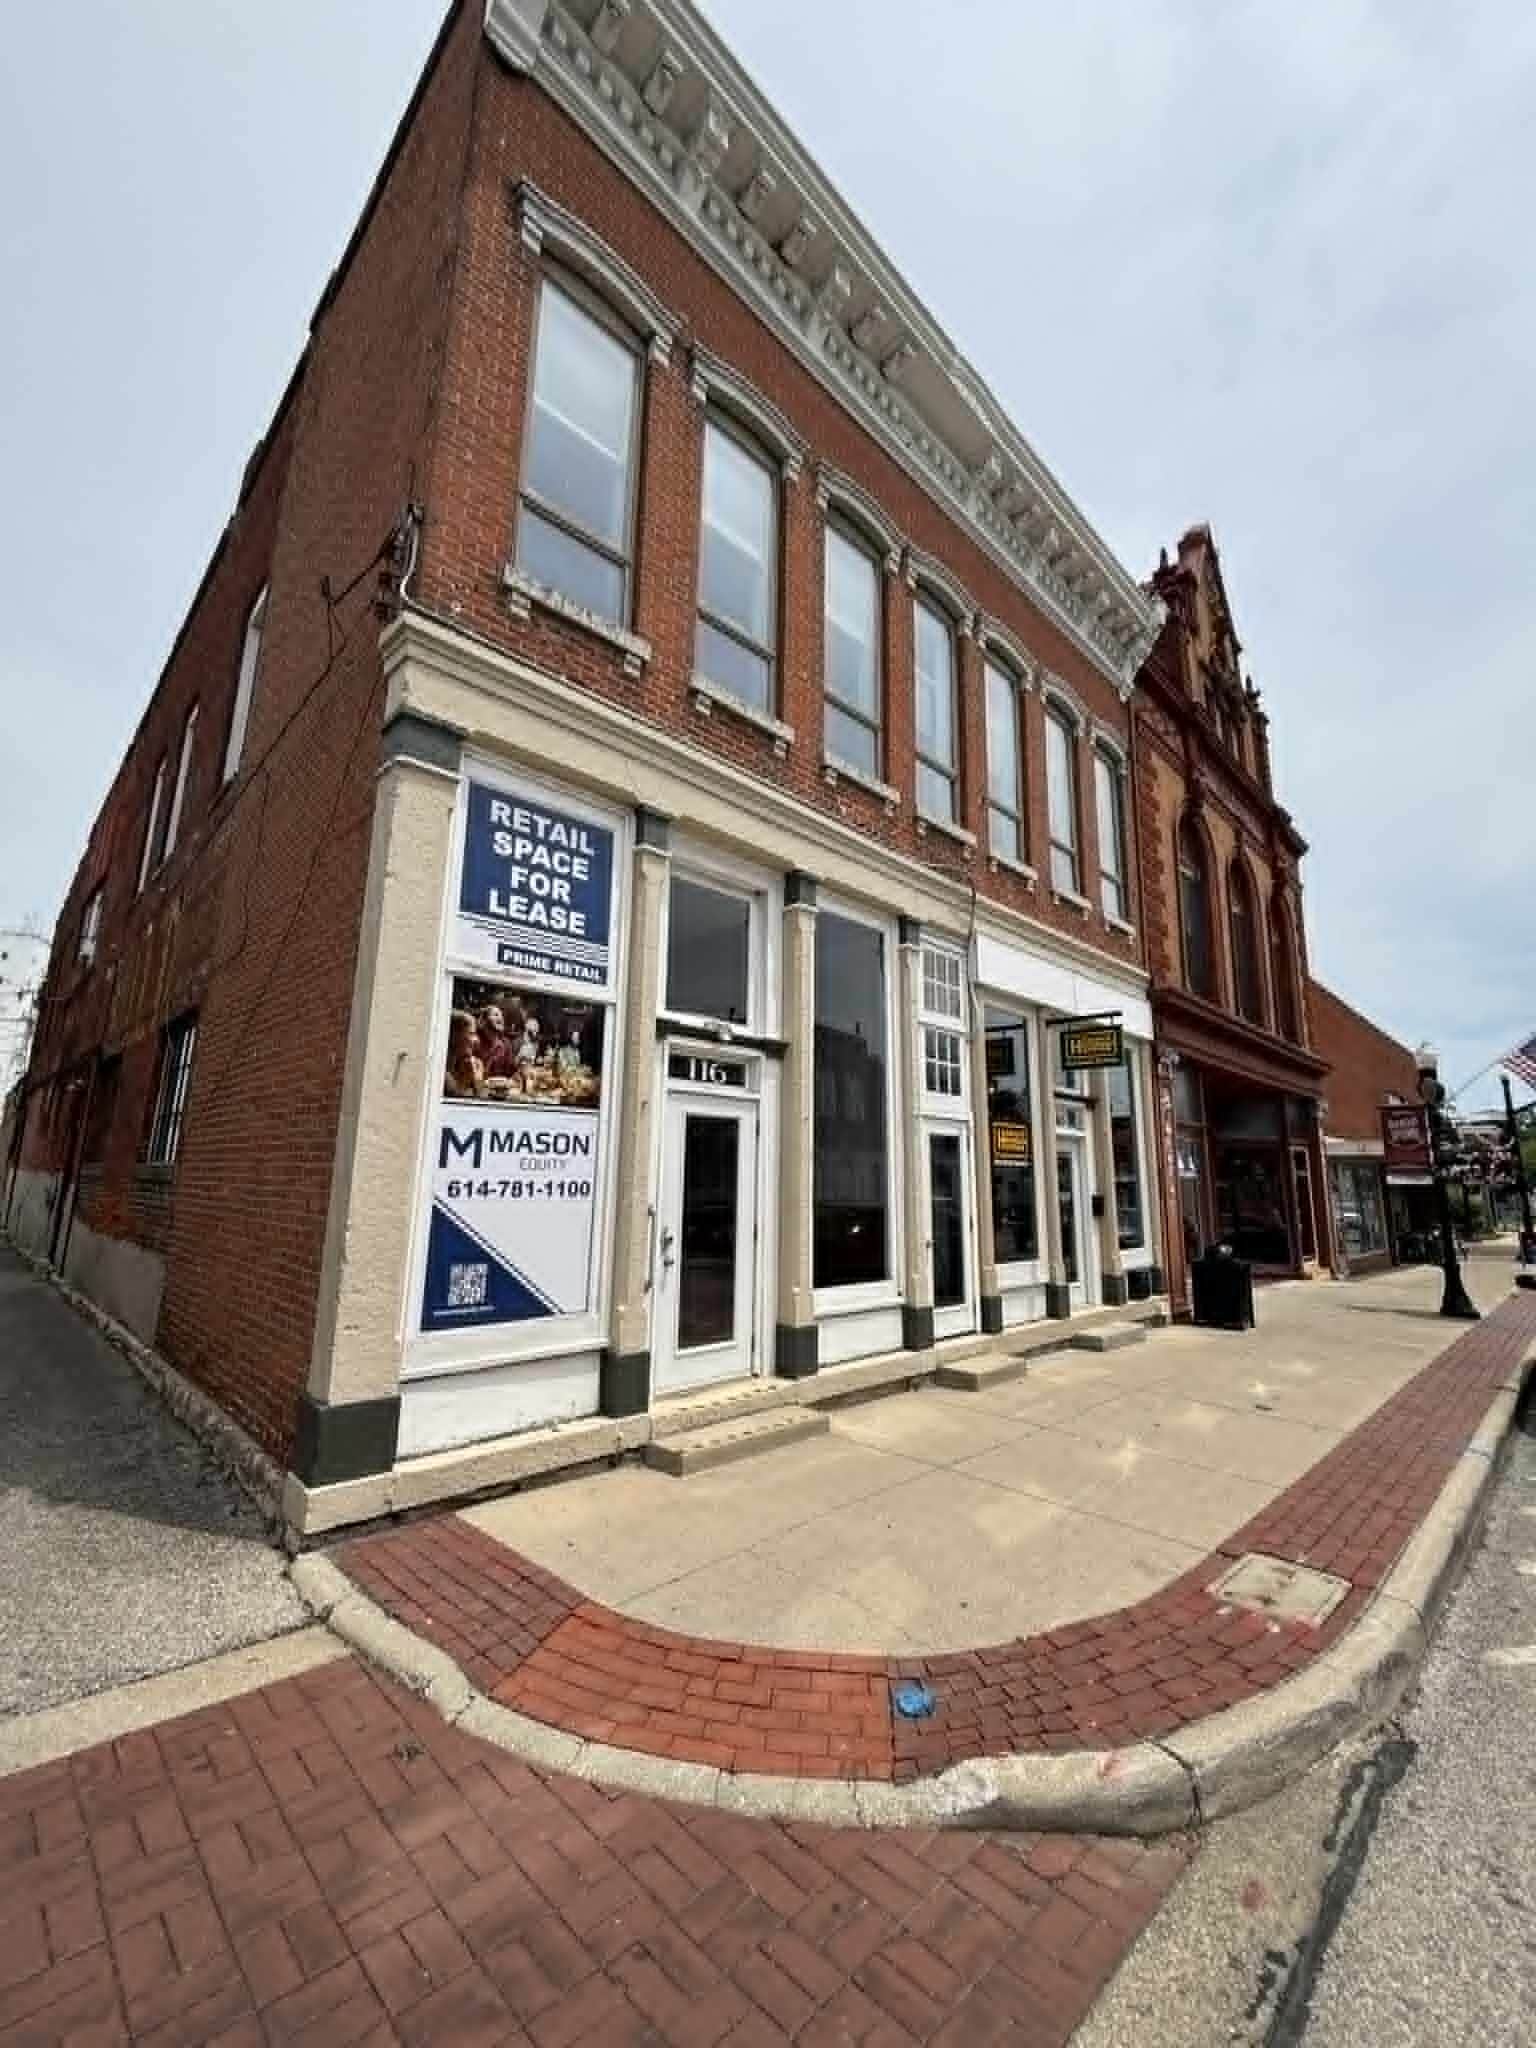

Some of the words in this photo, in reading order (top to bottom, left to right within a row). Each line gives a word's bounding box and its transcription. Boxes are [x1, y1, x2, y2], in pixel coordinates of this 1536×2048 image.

[489, 800, 595, 857] RETAIL
[493, 831, 589, 880] SPACE
[511, 865, 571, 905] FOR
[488, 888, 586, 934] LEASE
[503, 948, 552, 972] PRIME
[554, 958, 603, 983] RETAIL
[689, 1055, 728, 1087] 116
[489, 1129, 591, 1156] MASON
[447, 1179, 591, 1199] 614-781-1100
